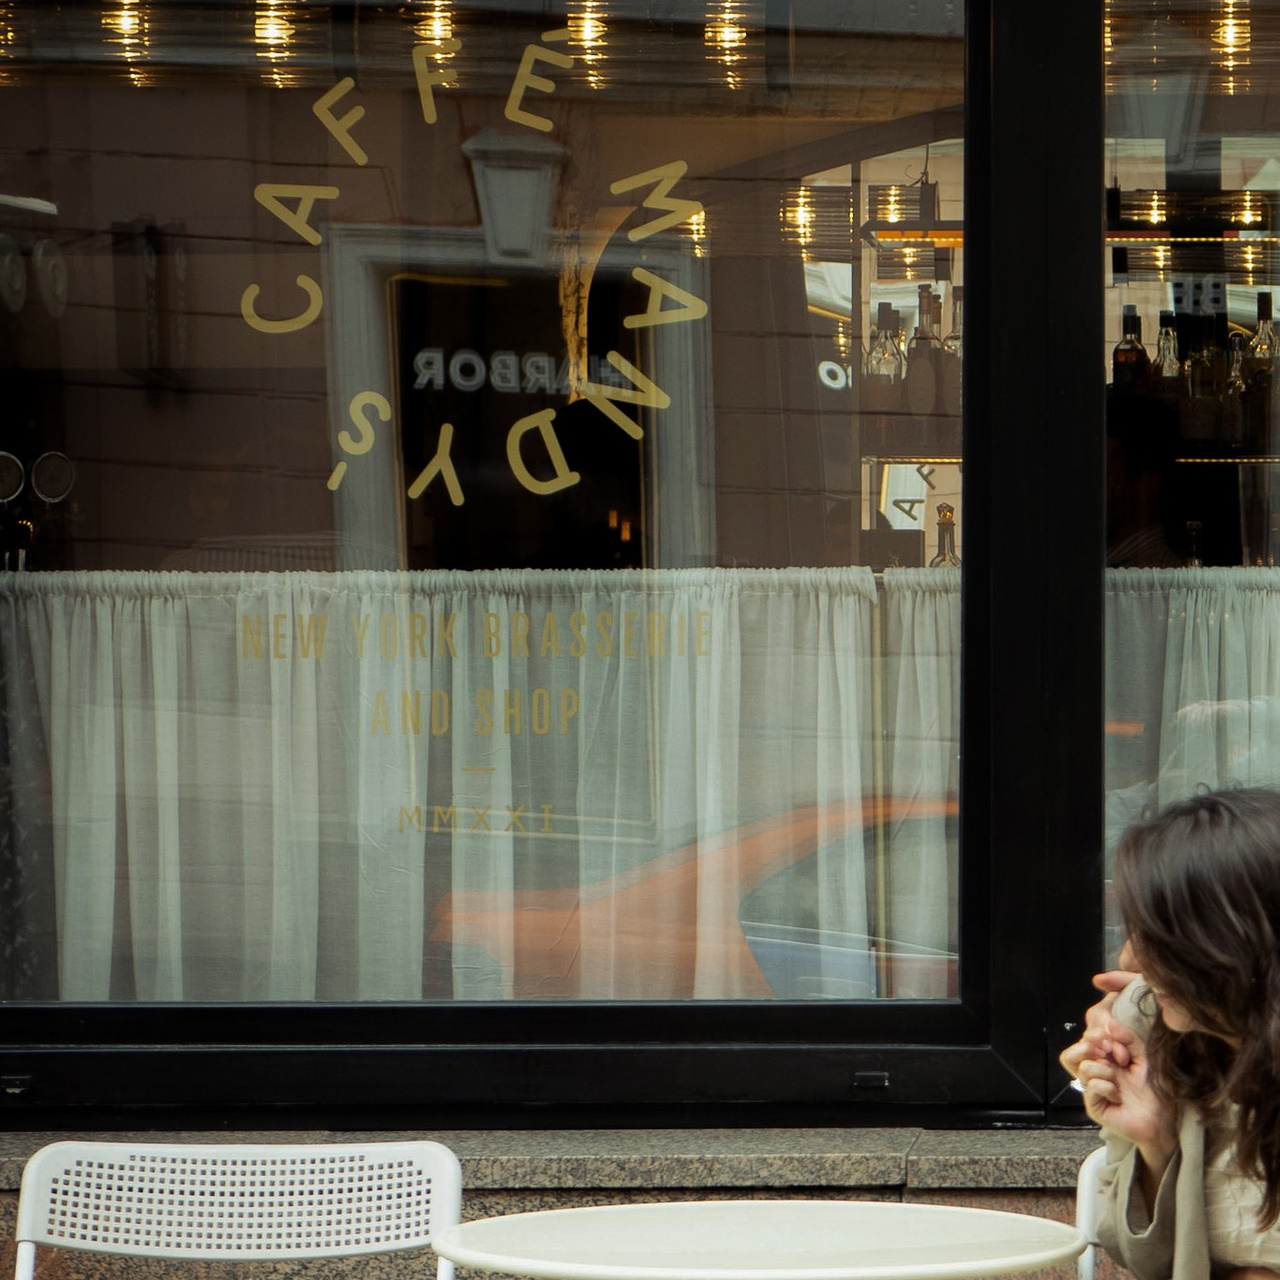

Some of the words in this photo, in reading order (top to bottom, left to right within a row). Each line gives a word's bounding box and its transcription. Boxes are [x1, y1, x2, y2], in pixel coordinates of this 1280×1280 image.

[241, 28, 573, 334] CAFFÉ
[241, 612, 328, 659] NEW
[352, 611, 458, 659] YORK
[483, 610, 713, 659] BRASSERIE
[370, 689, 450, 737] AND
[476, 688, 579, 736] SHOP
[399, 803, 554, 834] MMXXI
